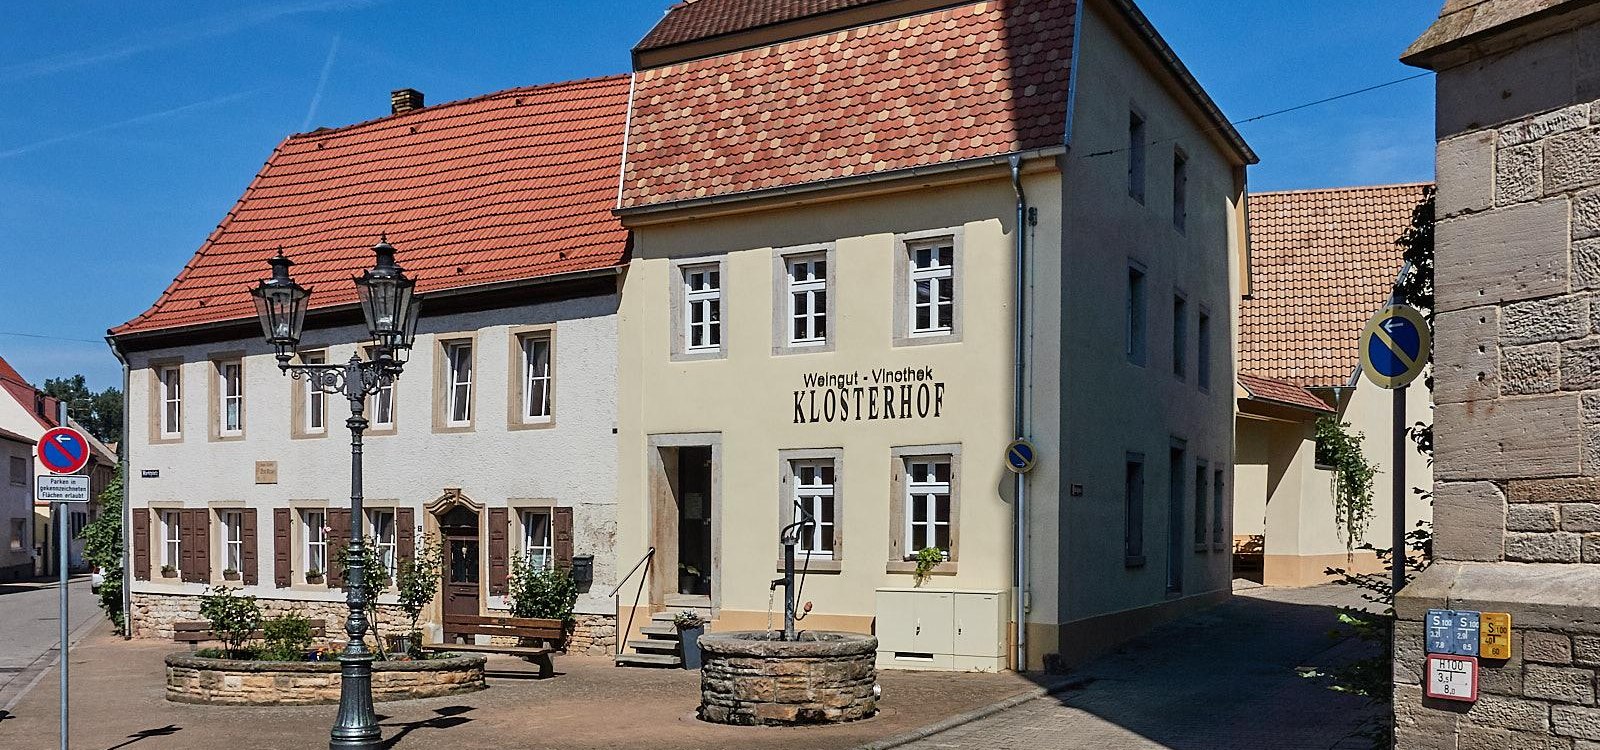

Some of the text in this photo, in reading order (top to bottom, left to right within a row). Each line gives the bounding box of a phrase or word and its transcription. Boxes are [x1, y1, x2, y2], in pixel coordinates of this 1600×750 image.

[803, 371, 858, 389] Weingut
[872, 365, 933, 384] Vinothek
[793, 382, 945, 424] KLOSTERHOF
